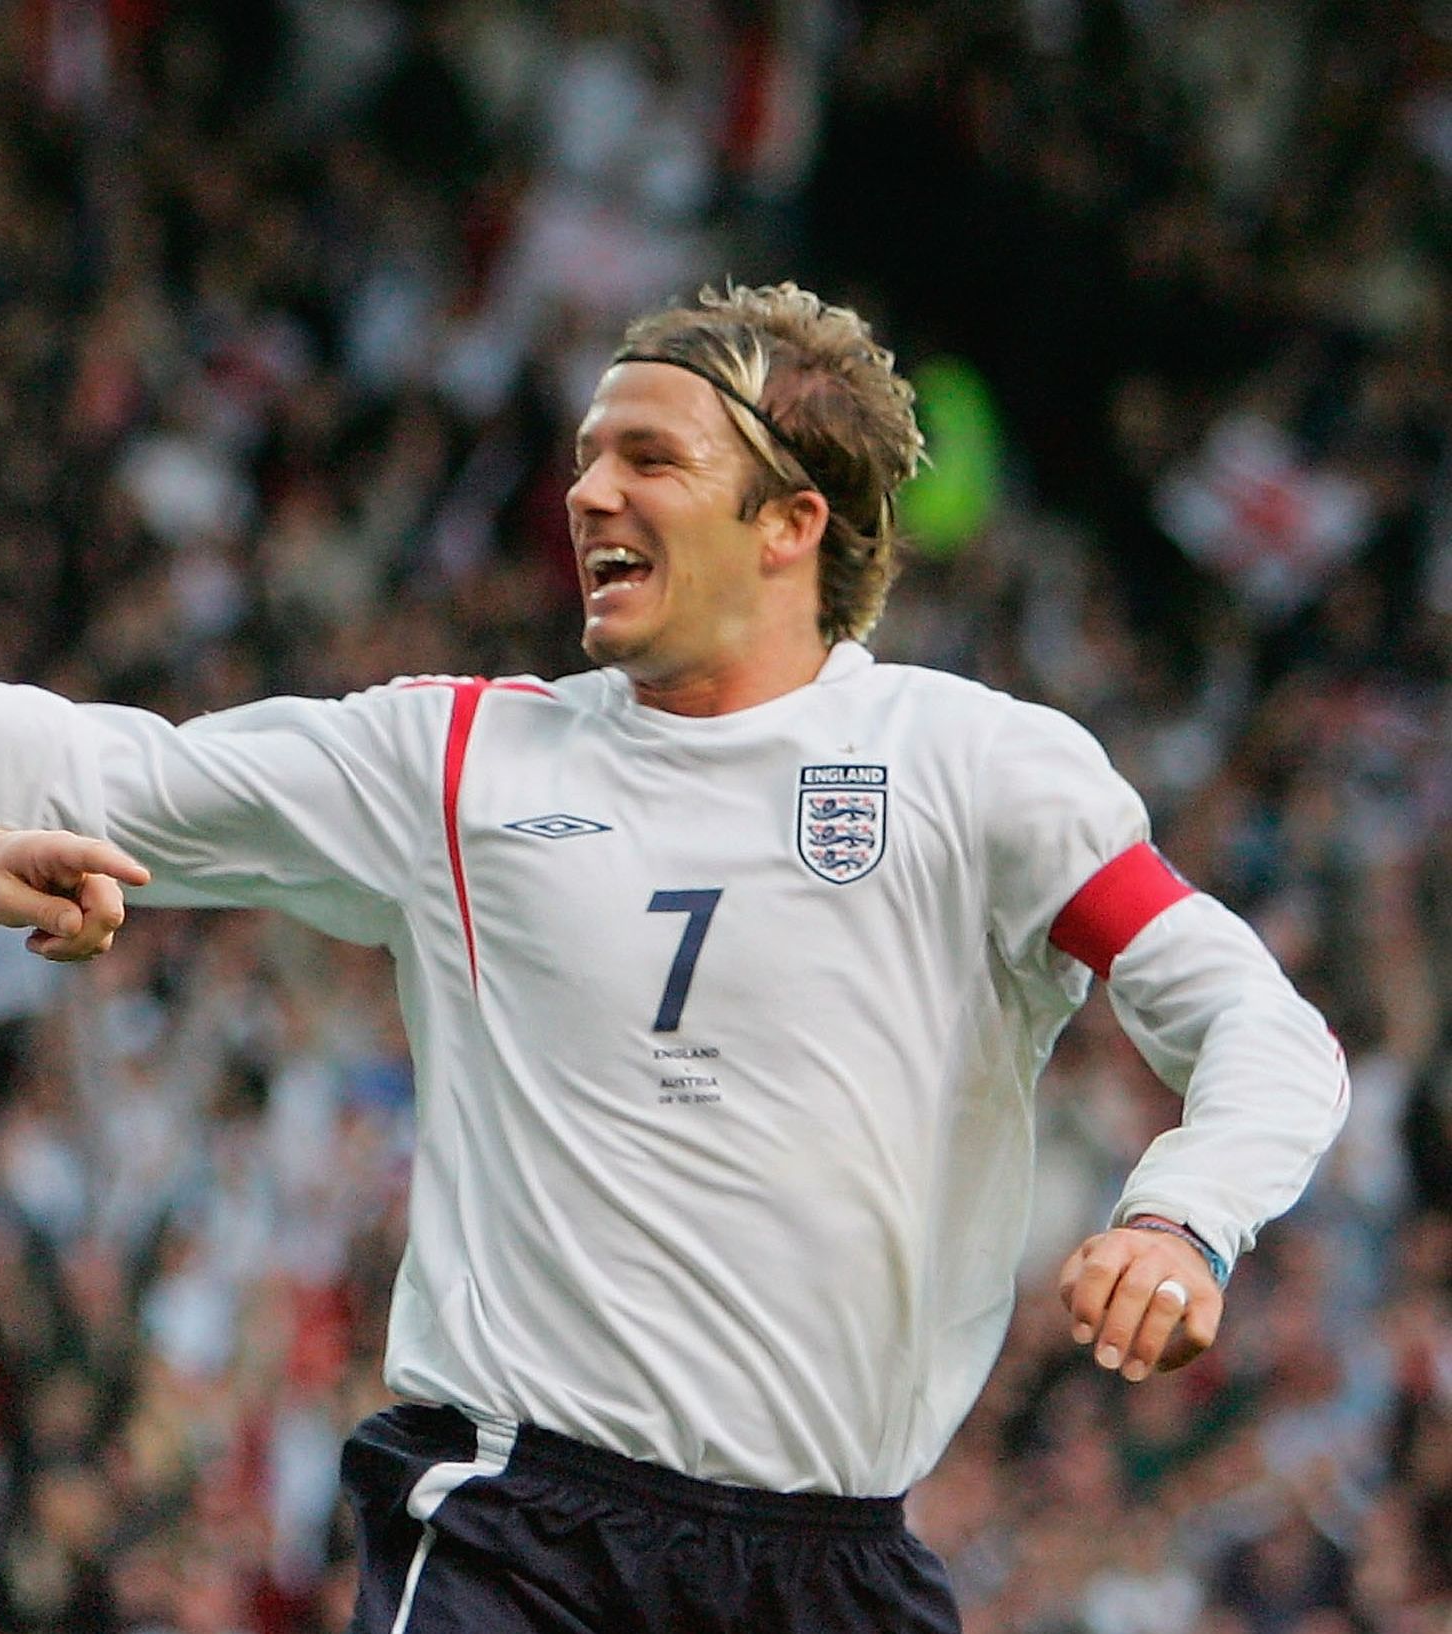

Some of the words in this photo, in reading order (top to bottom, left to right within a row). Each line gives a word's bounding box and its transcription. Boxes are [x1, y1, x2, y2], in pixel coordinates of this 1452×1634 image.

[804, 767, 884, 783] ENGLAND
[647, 887, 724, 1032] 7
[653, 1046, 720, 1059] ENGLAND
